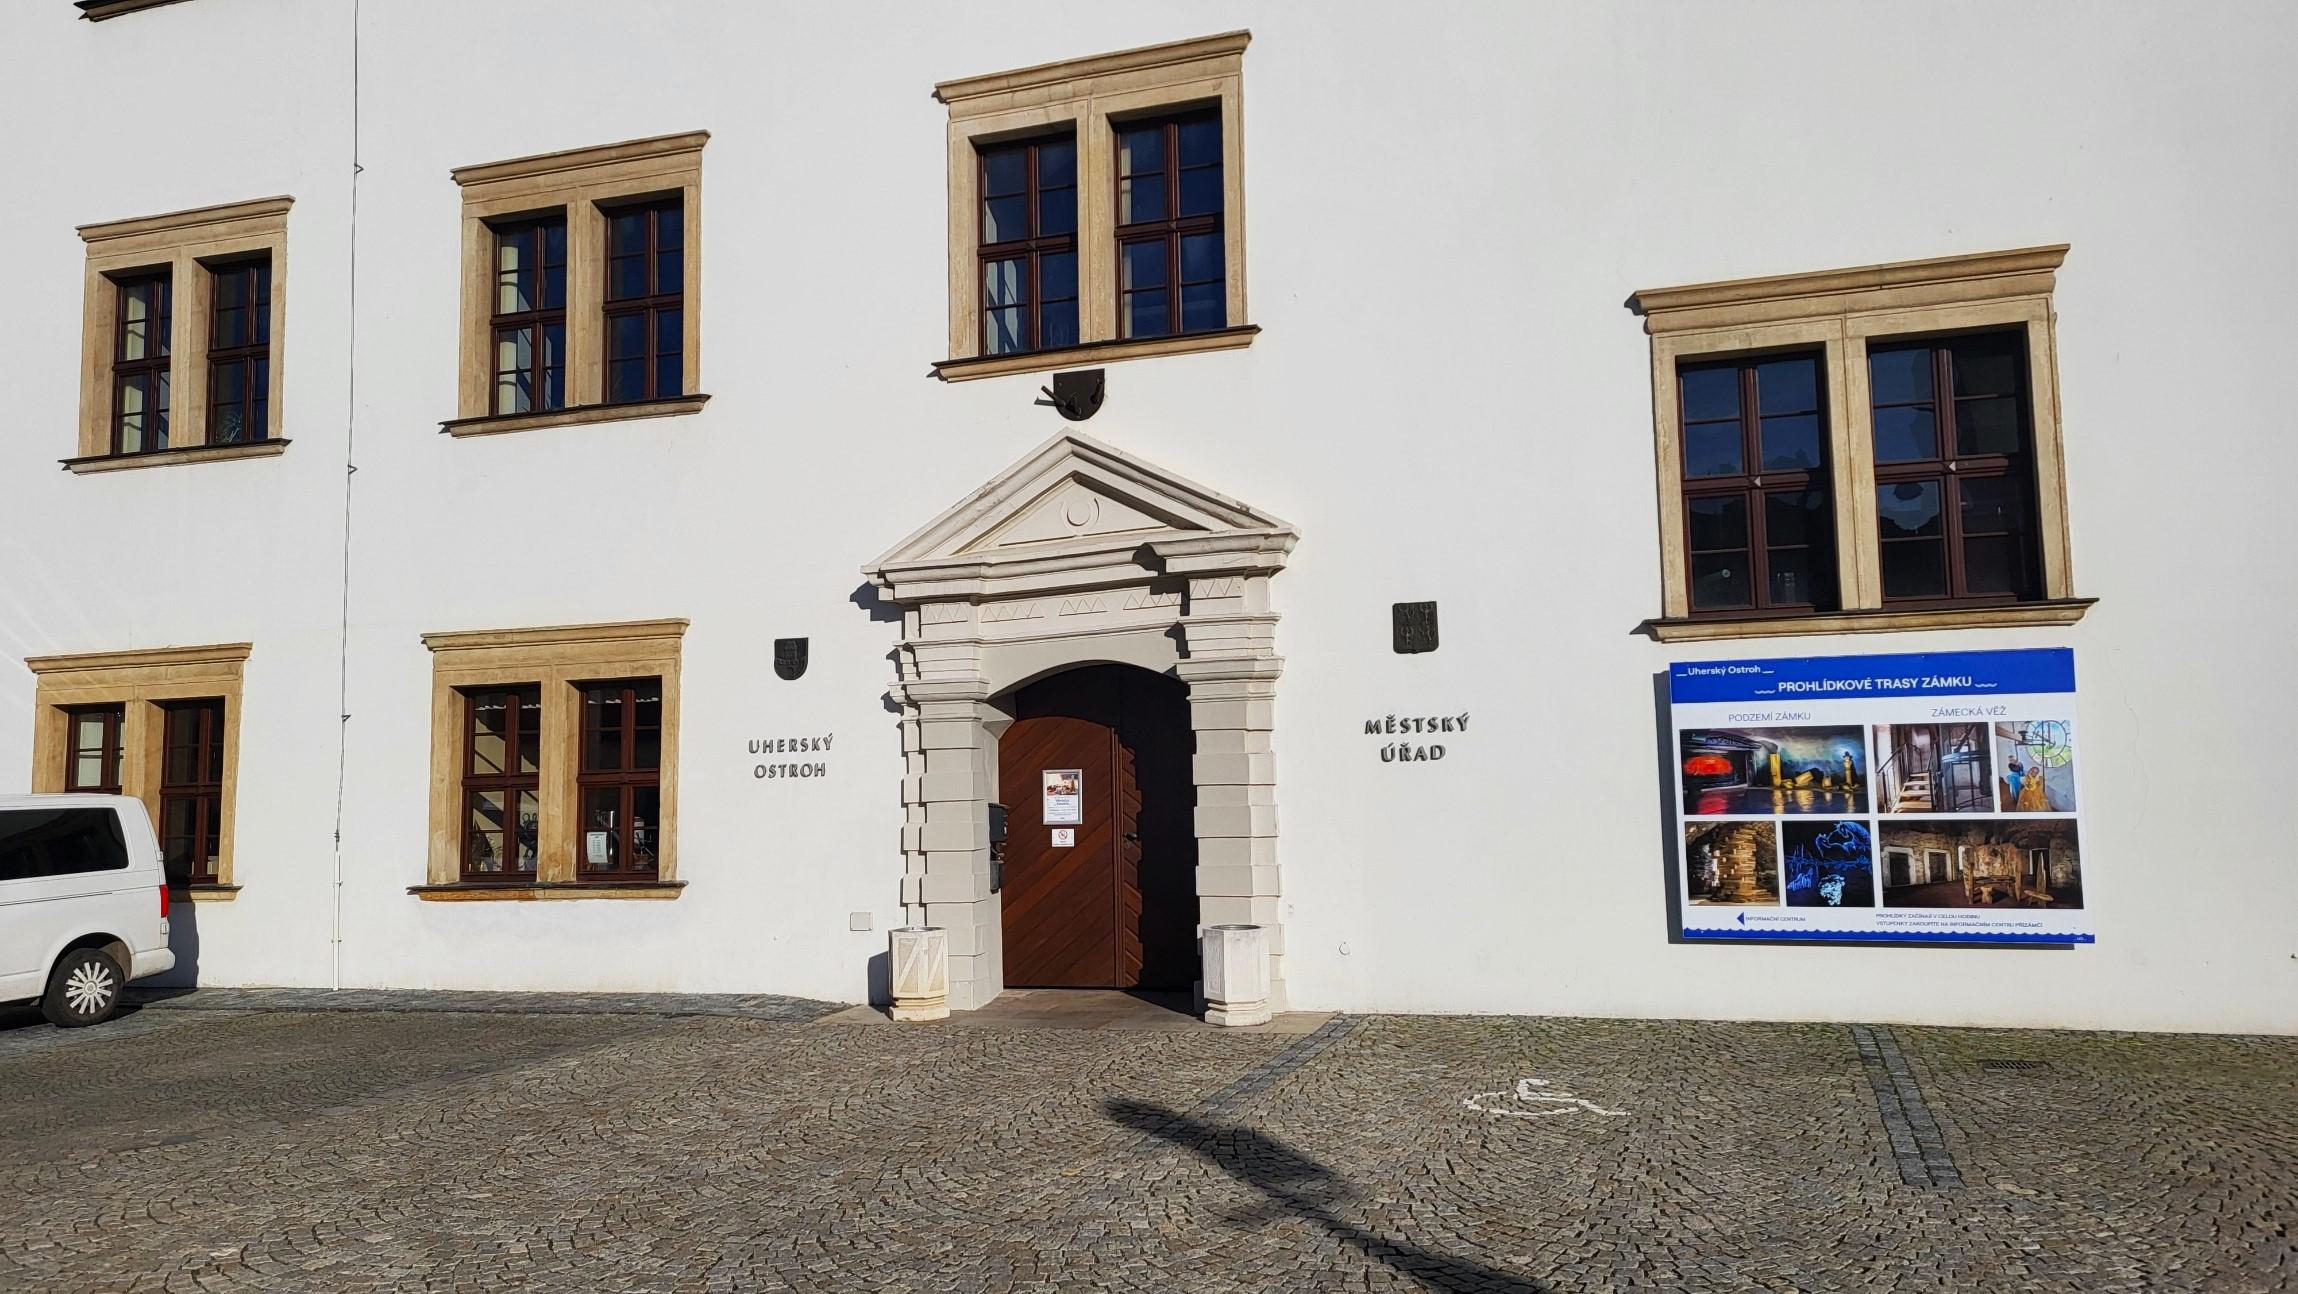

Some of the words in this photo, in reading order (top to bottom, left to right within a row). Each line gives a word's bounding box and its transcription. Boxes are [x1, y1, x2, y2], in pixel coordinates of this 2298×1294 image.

[1687, 666, 1726, 677] Uherský
[1728, 665, 1761, 674] Ostroh
[1778, 676, 1873, 692] PROHLÍDKOVÉ
[1875, 677, 1919, 689] TRASY
[1921, 675, 1972, 688] ZÁMKU
[1728, 711, 1773, 722] PODZEMÍ
[1775, 711, 1811, 721] ZÁMKU
[1931, 706, 1983, 717] ZÁMECKÁ
[1985, 705, 2007, 716] VĚŽ
[1364, 712, 1470, 734] MĚSTSKÝ
[748, 732, 833, 753] UHERSKÝ
[1380, 742, 1446, 762] ÚŘAD
[754, 762, 825, 778] OSTROH
